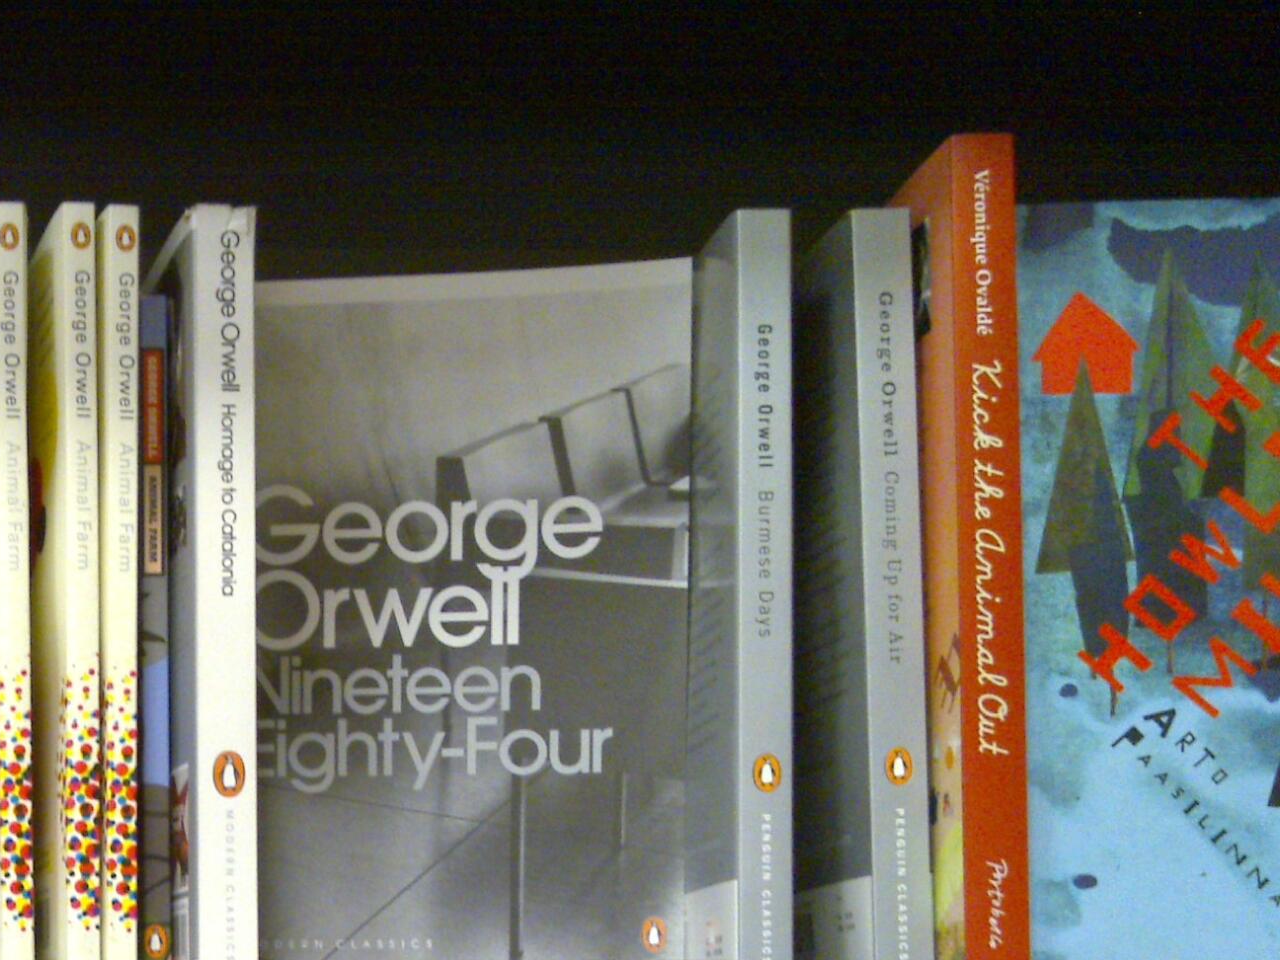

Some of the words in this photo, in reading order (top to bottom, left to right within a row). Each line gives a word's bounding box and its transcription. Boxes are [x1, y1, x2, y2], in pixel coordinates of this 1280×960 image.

[970, 169, 991, 264] Véronique
[0, 271, 19, 345] George
[72, 271, 91, 344] George
[116, 272, 135, 345] George
[216, 230, 240, 318] George
[976, 270, 993, 335] Ovaldé
[221, 323, 240, 392] Orwell
[754, 324, 773, 393] George
[876, 291, 894, 373] George
[4, 353, 21, 420] Orwell
[76, 353, 92, 418] Orwell
[120, 354, 136, 420] Orwell
[881, 382, 898, 457] Orwell
[972, 359, 1003, 449] Kick
[217, 404, 237, 483] Homage
[757, 405, 774, 468] Orwell
[6, 441, 21, 513] Animal
[77, 441, 92, 513] Animal
[120, 442, 134, 514] Animal
[221, 490, 237, 505] to
[973, 459, 1005, 520] the
[7, 521, 22, 571] Farm
[77, 521, 93, 570] Farm
[120, 522, 134, 572] Farm
[255, 484, 604, 580] George
[758, 491, 775, 579] Burmese
[881, 471, 900, 558] Coming
[221, 509, 238, 596] Catalonia
[883, 560, 902, 586] Up
[255, 569, 521, 650] Orwell
[755, 591, 775, 638] Days
[889, 595, 904, 622] for
[975, 528, 1009, 686] Animal
[889, 634, 905, 664] Air
[256, 654, 542, 716] Nineteen
[978, 693, 1011, 756] Out
[1144, 708, 1228, 785] ARTO
[761, 814, 771, 881] PENGUIN
[895, 808, 906, 876] PENGUIN
